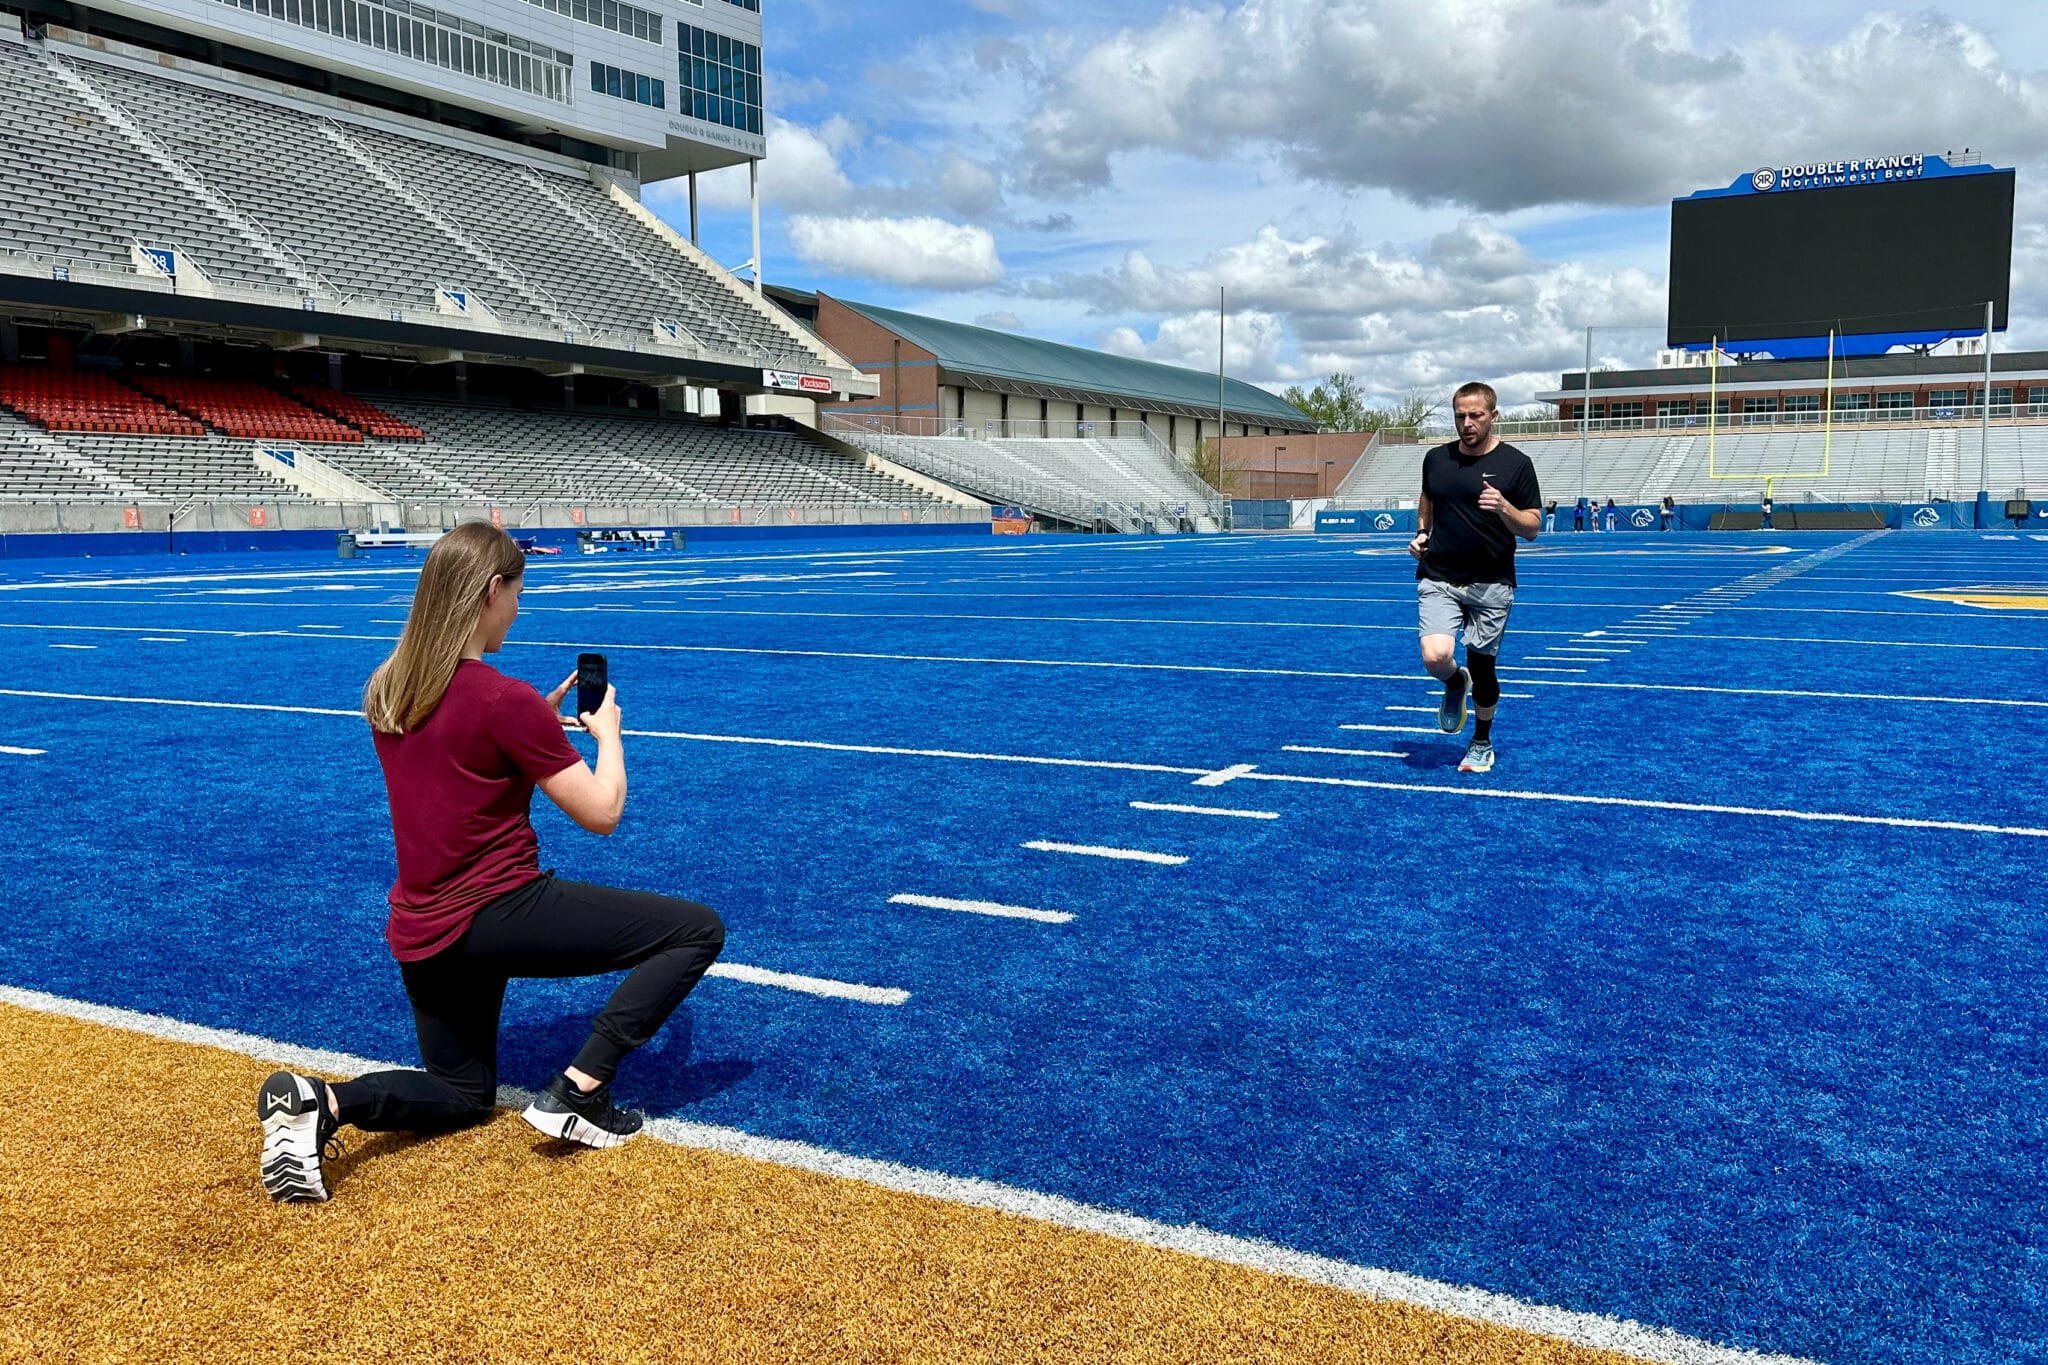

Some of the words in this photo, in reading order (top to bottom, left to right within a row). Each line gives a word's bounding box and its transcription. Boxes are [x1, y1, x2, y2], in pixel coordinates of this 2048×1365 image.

[1780, 171, 1876, 188] Northwest
[1885, 166, 1924, 180] Beef
[1781, 161, 1845, 178] DOUBLE
[1850, 160, 1860, 172] R
[1865, 154, 1924, 170] RANCH
[803, 377, 829, 389] Jacksons
